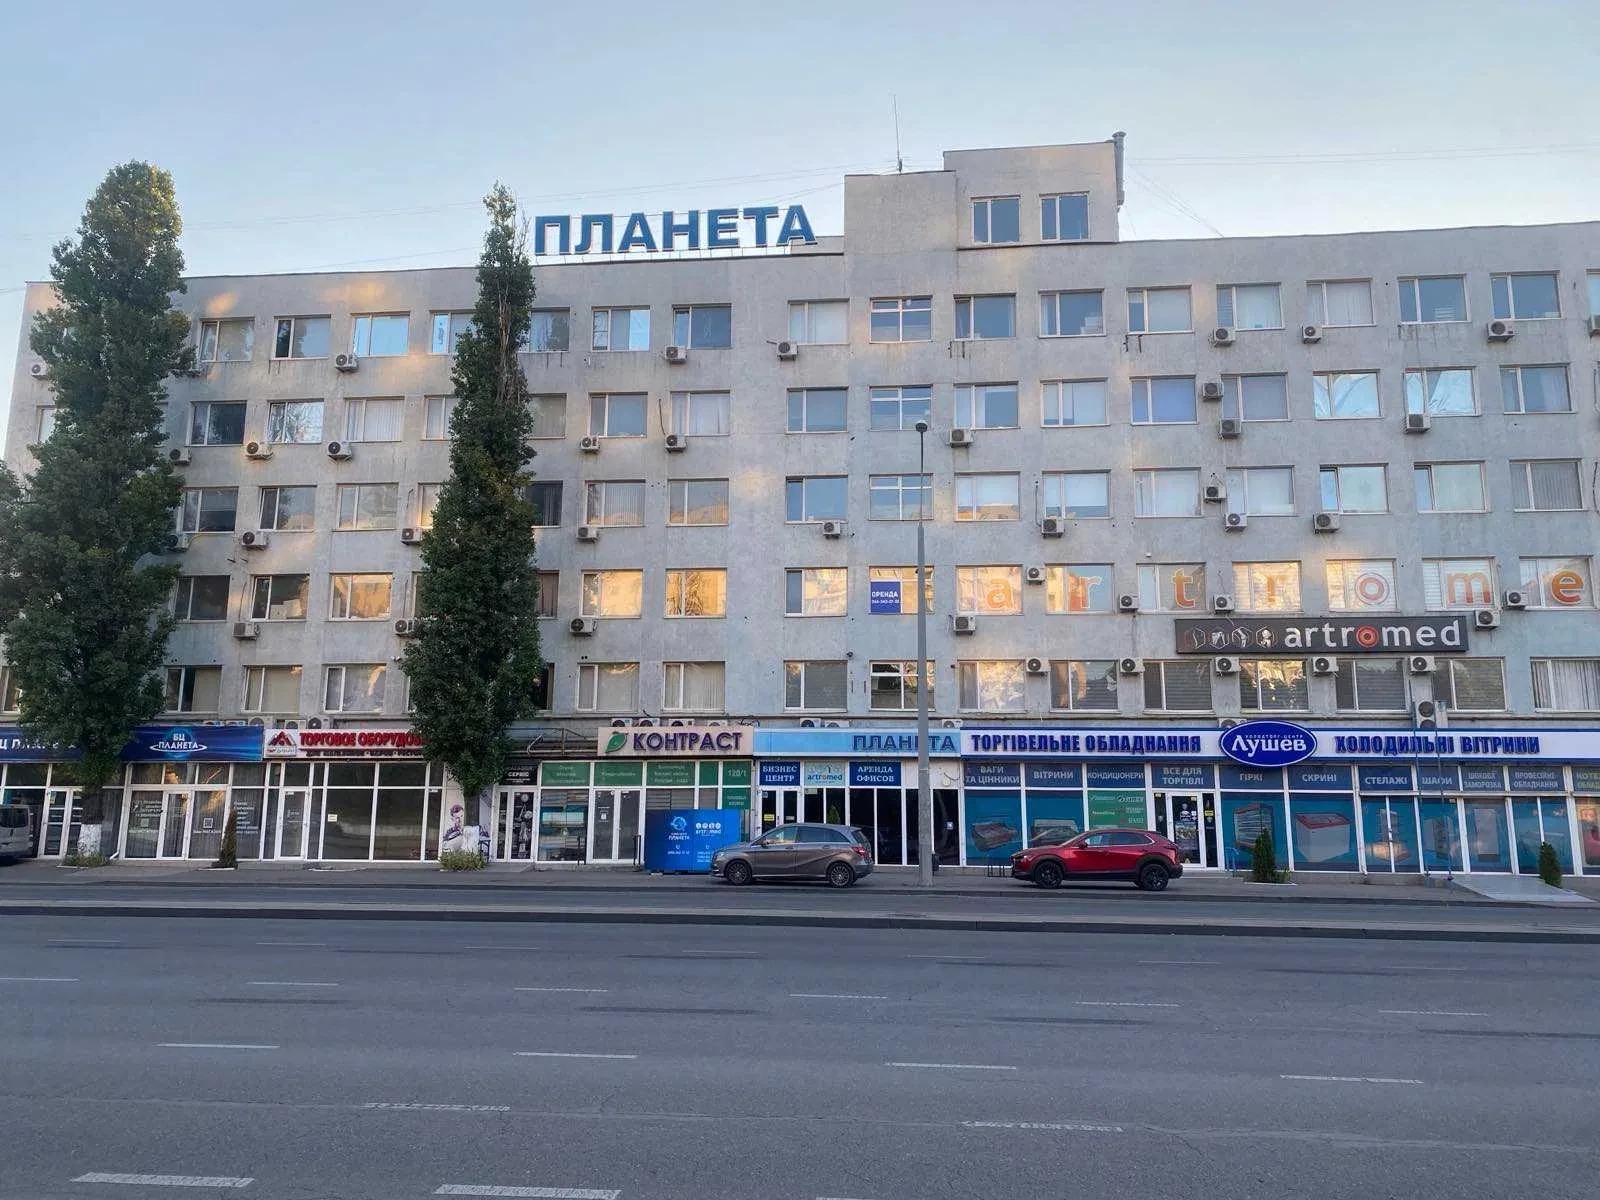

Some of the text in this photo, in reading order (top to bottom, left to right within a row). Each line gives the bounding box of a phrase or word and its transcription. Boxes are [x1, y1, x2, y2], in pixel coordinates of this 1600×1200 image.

[534, 204, 818, 256] ПЛАНЕТА
[1284, 620, 1462, 648] artromed
[172, 733, 186, 742] БЦ
[299, 732, 431, 748] ТОРГОВОЕ ОБОРУДОВ
[633, 732, 742, 752] КОНТРАСТ
[157, 741, 199, 750] ПЛАНЕТА
[972, 734, 1201, 754] ТОРГІВЕЛЬНЕ ОБЛАДНАННЯ
[1231, 735, 1307, 758] Лушев
[1335, 736, 1540, 755] ХОЛОДИЛЬНІ ВІТРИНИ
[762, 765, 798, 773] БИЗНЕС
[857, 765, 894, 774] АРЕНДА
[979, 766, 1005, 774] ВАГИ
[1163, 766, 1202, 776] ВСЕ ДЛЯ
[764, 774, 796, 783] ЦЕНТР
[856, 774, 895, 783] ОФИСОВ
[964, 775, 1020, 785] ТА ЦІННИКИ
[1033, 771, 1074, 780] ВІТРИНИ
[1087, 771, 1144, 781] КОНДИЦІОНЕРИ
[1239, 773, 1263, 781] ГІРКІ
[1301, 774, 1337, 783] СКРИНІ
[1161, 776, 1204, 785] ТОРГІВЛІ
[1364, 776, 1408, 785] СТЕЛАЖІ
